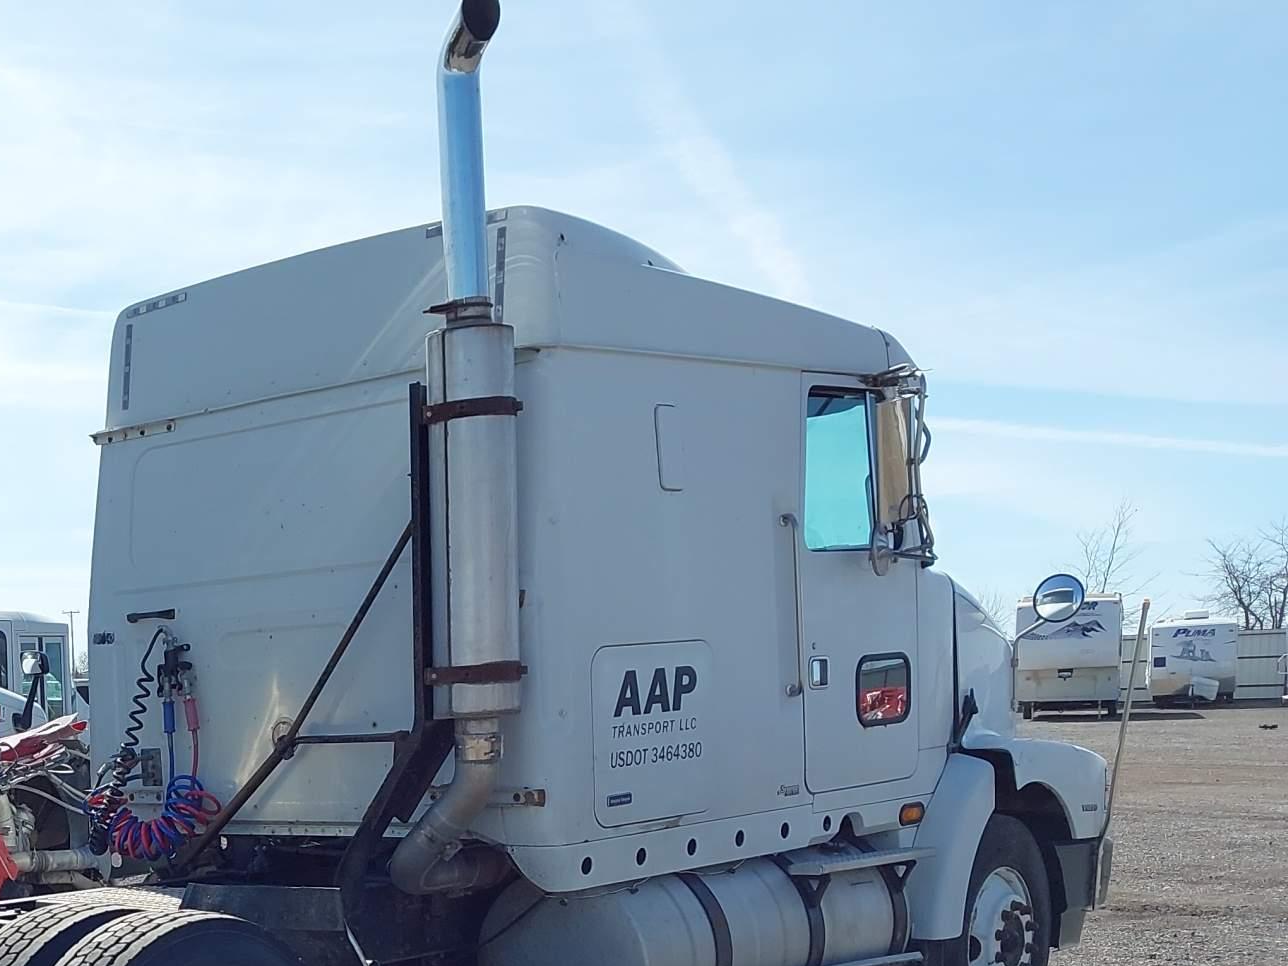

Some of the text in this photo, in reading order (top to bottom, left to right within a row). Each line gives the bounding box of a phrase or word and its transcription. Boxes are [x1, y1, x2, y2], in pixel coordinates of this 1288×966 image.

[613, 665, 698, 718] AAP
[612, 717, 697, 738] TRANSPORT LLC
[610, 741, 702, 769] USDOT 3464380
